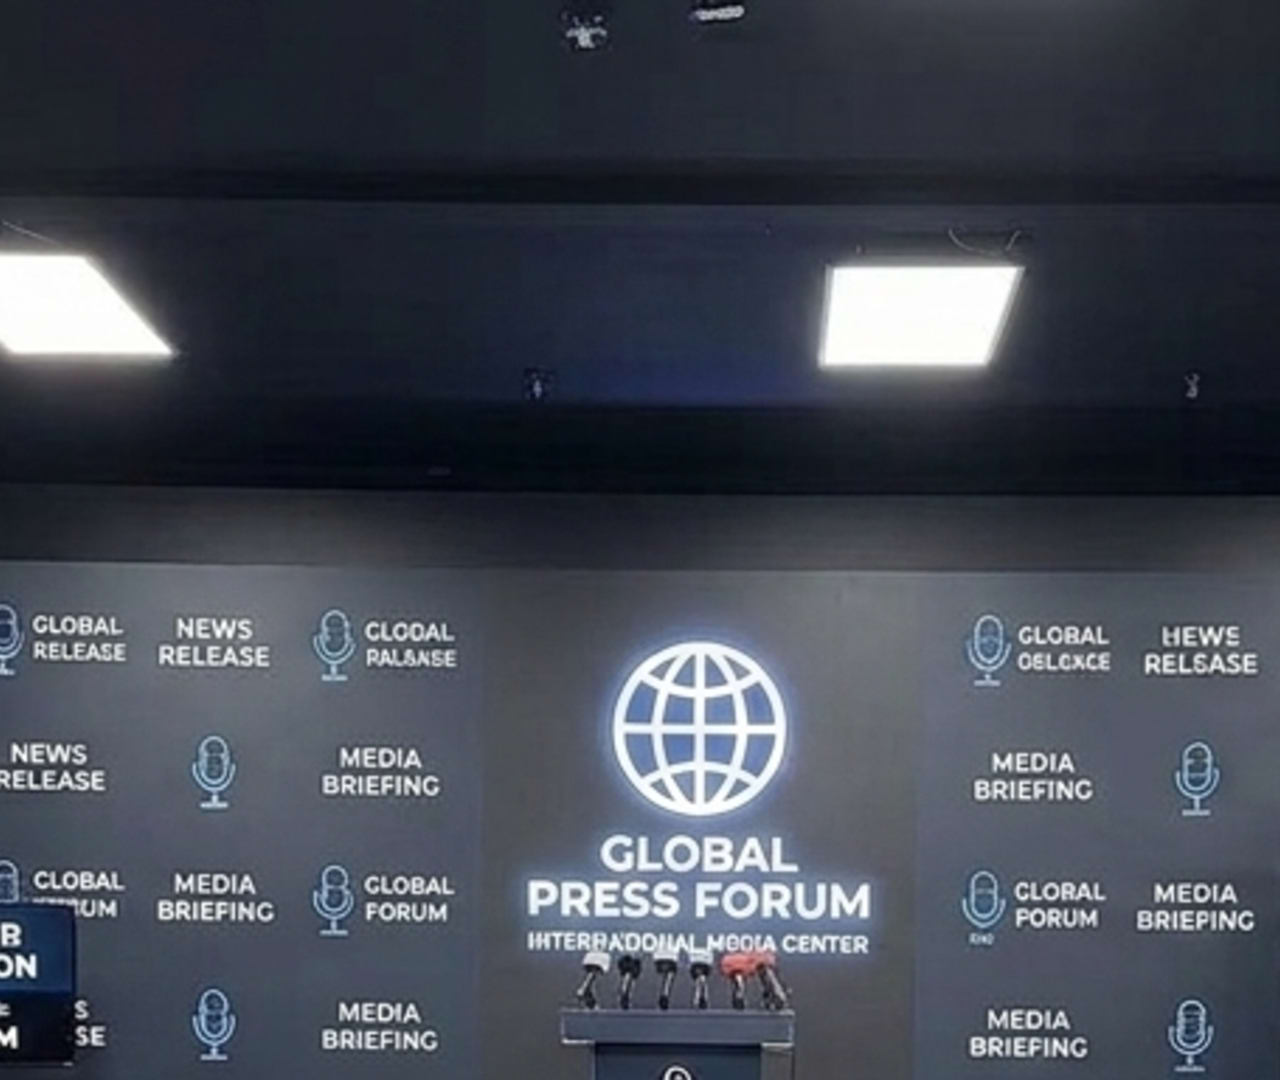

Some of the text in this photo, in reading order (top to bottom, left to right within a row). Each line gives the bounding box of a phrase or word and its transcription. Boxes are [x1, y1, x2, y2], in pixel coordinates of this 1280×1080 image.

[177, 617, 253, 640] NEWS
[33, 641, 126, 662] RELEASE
[158, 645, 270, 667] RELEASE
[11, 743, 88, 765] NEWS
[340, 747, 422, 769] MEDIA
[992, 752, 1075, 773] MEDIA
[322, 774, 440, 797] BRIEFING
[974, 779, 1093, 801] BRIEFING
[600, 834, 799, 873] GLOBAL
[174, 873, 256, 895] MEDIA
[364, 875, 455, 896] GLOBAL
[1154, 883, 1238, 904] MEDIA
[157, 899, 274, 922] BRIEFING
[528, 880, 870, 920] PRESS FORUM
[365, 901, 448, 922] FORUM
[781, 934, 869, 954] CENTER
[338, 1002, 421, 1024] MEDIA
[988, 1009, 1071, 1030] MEDIA
[322, 1029, 438, 1051] BRIEFING
[969, 1036, 1088, 1058] BRIEFING
